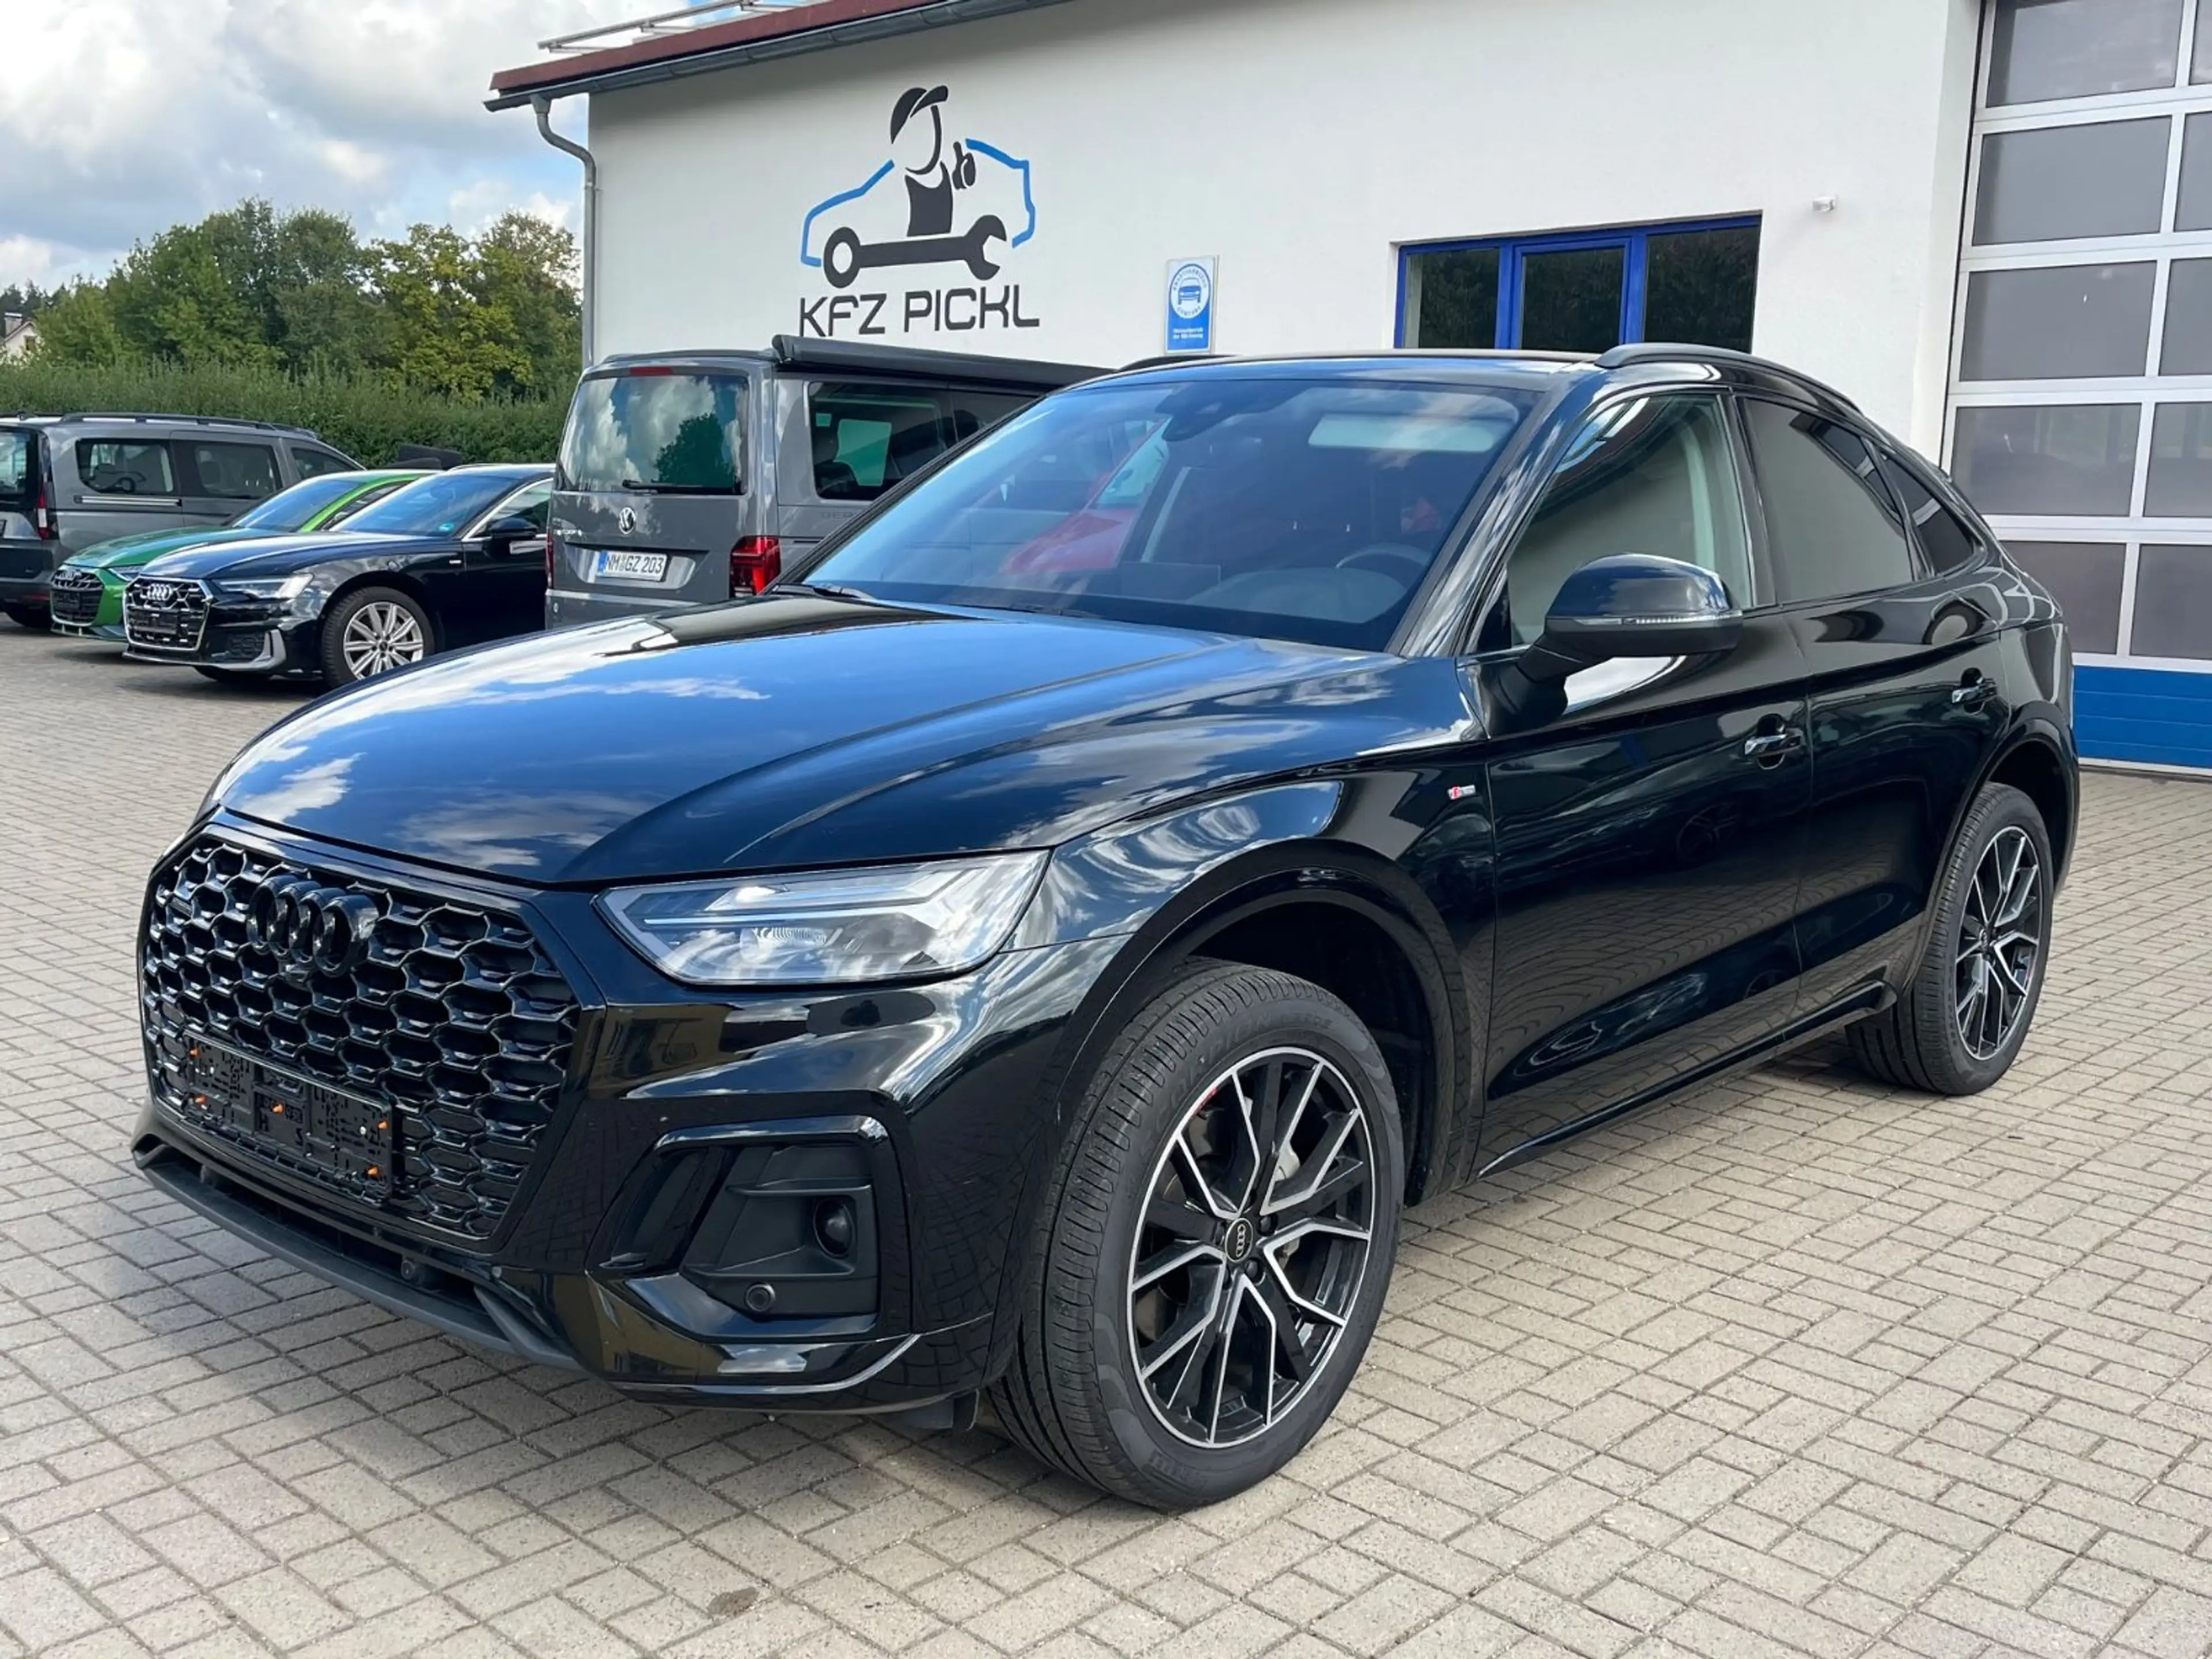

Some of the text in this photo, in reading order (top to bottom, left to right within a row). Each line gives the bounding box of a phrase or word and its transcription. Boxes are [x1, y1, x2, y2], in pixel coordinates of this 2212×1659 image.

[799, 285, 1040, 337] KFZ PICKL
[642, 556, 664, 574] 203
